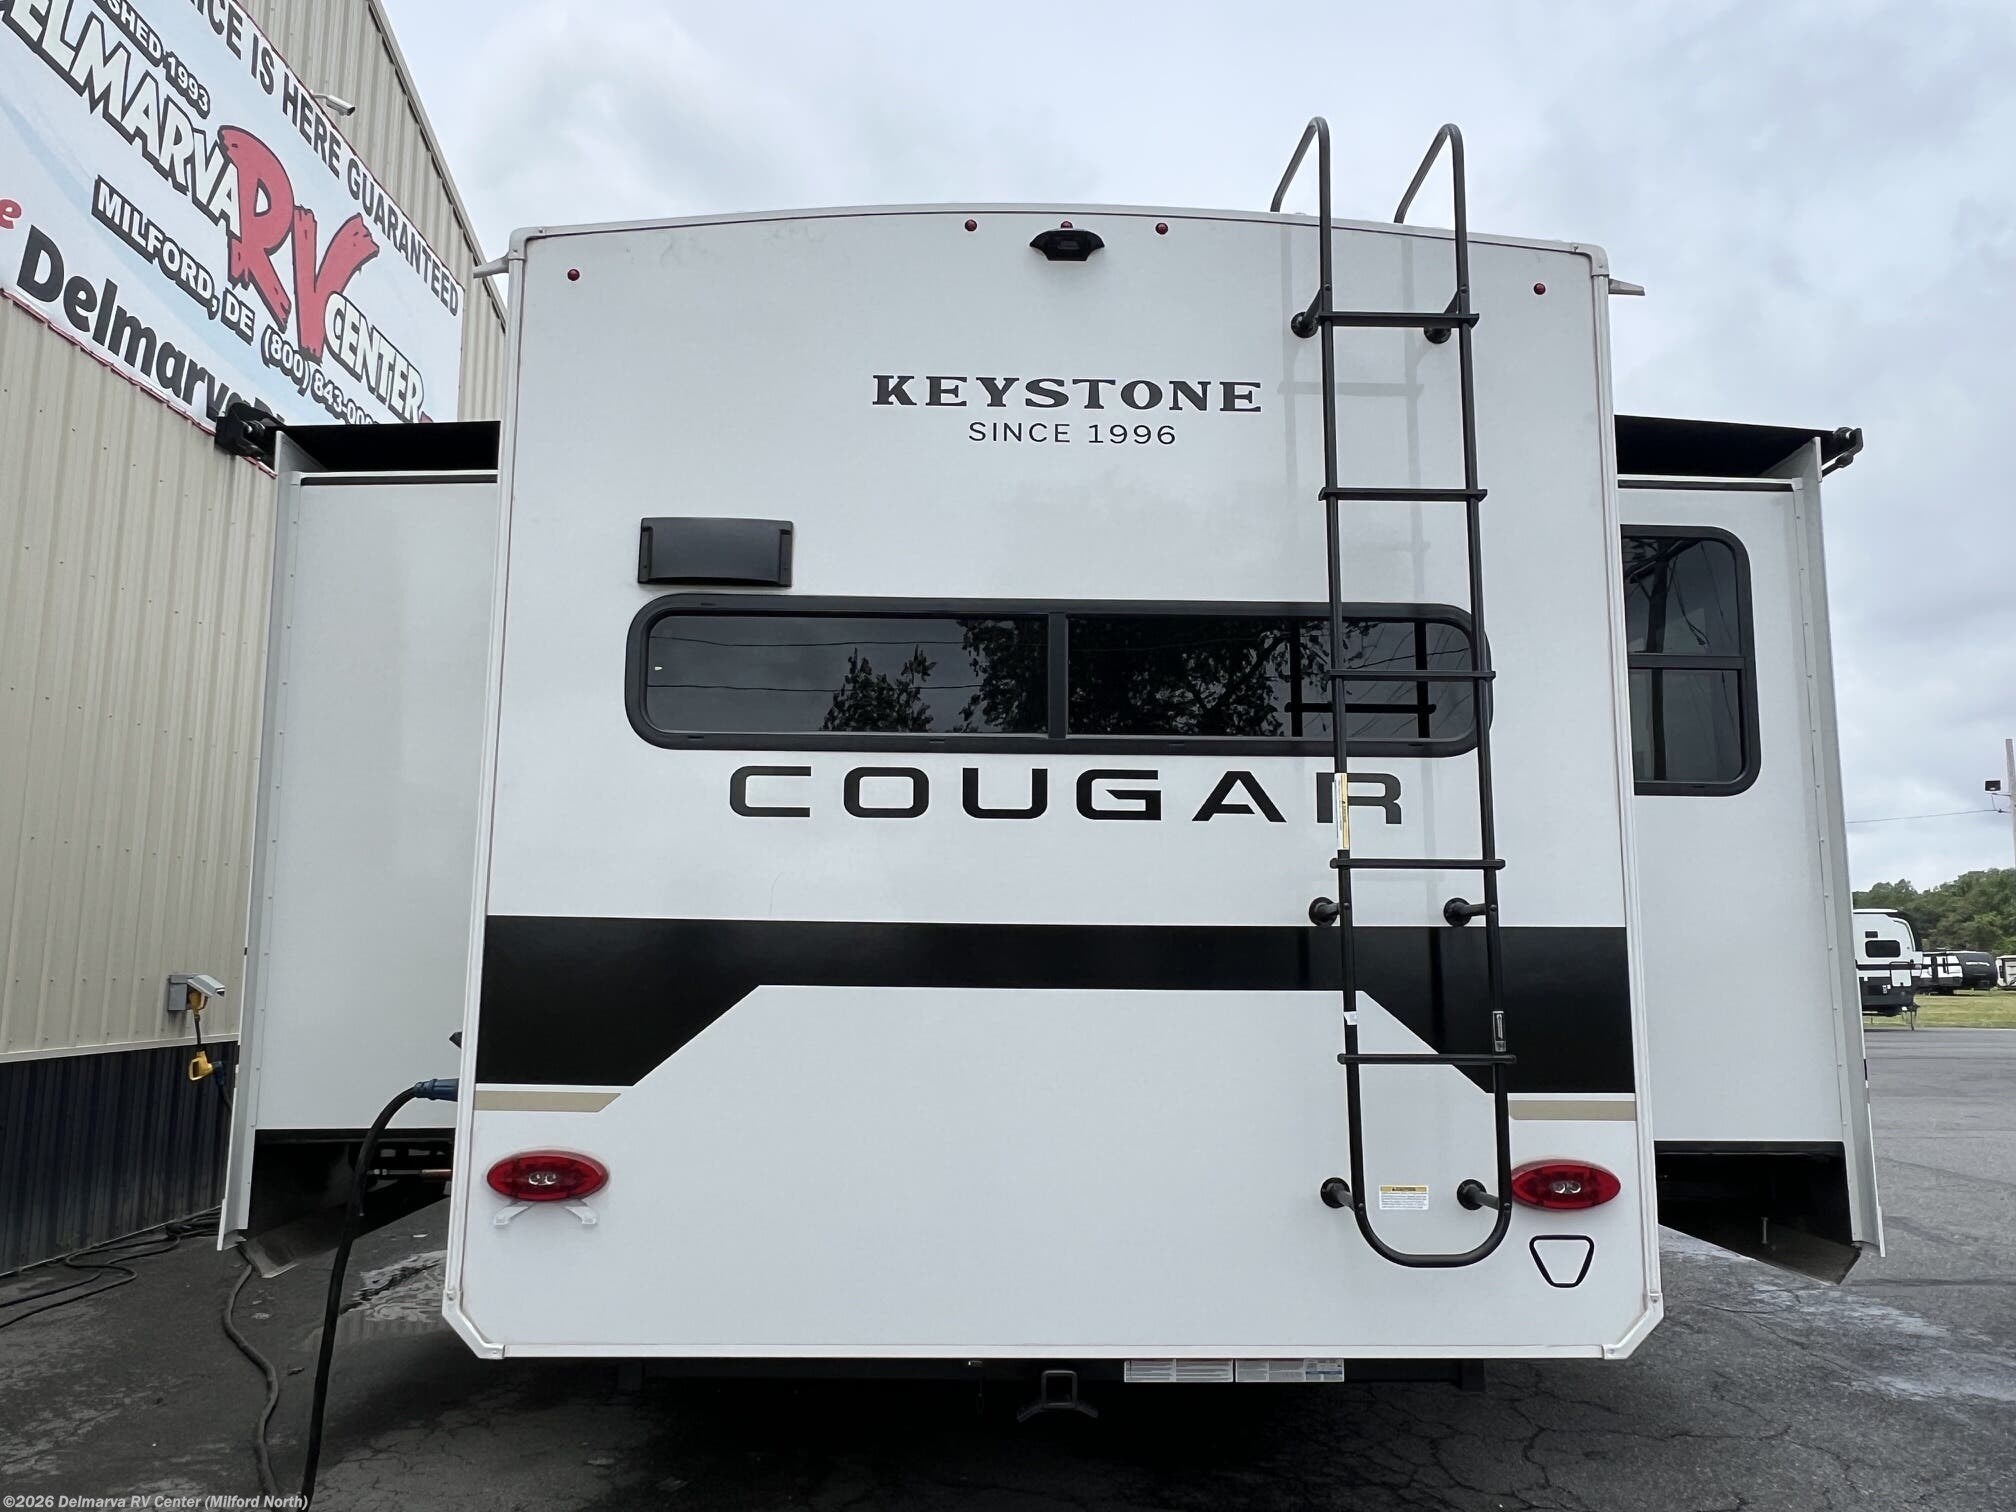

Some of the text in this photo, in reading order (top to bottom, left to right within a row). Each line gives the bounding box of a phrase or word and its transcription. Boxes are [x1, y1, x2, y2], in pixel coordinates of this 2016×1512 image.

[166, 52, 210, 116] 1993
[250, 33, 274, 95] IS
[282, 72, 342, 179] HERE
[347, 158, 460, 317] GUARANTEED
[95, 178, 219, 316] MILFORD,
[222, 289, 255, 343] DE
[263, 328, 311, 393] (800)
[218, 125, 380, 366] RV
[324, 291, 424, 423] CENTER
[871, 374, 1262, 413] KEYSTONE
[968, 421, 1177, 445] SINCE 1996
[729, 765, 1403, 825] COUGAR
